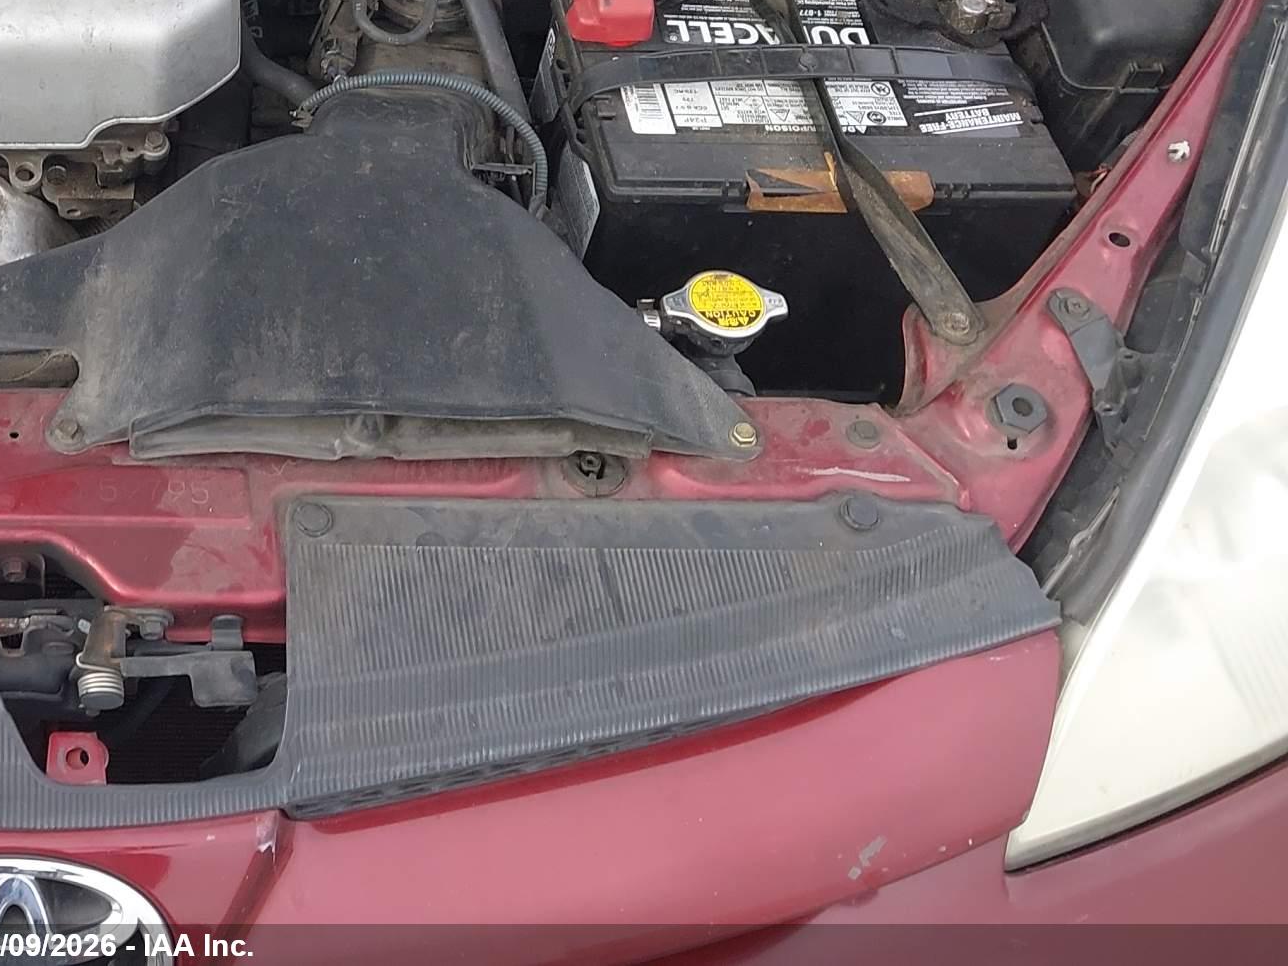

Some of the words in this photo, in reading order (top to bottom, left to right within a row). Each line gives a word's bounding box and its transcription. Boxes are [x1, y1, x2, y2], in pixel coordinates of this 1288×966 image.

[666, 19, 870, 46] DUACELL
[919, 112, 1022, 133] MAINTENANCE-FREE
[945, 108, 991, 121] BATTERY
